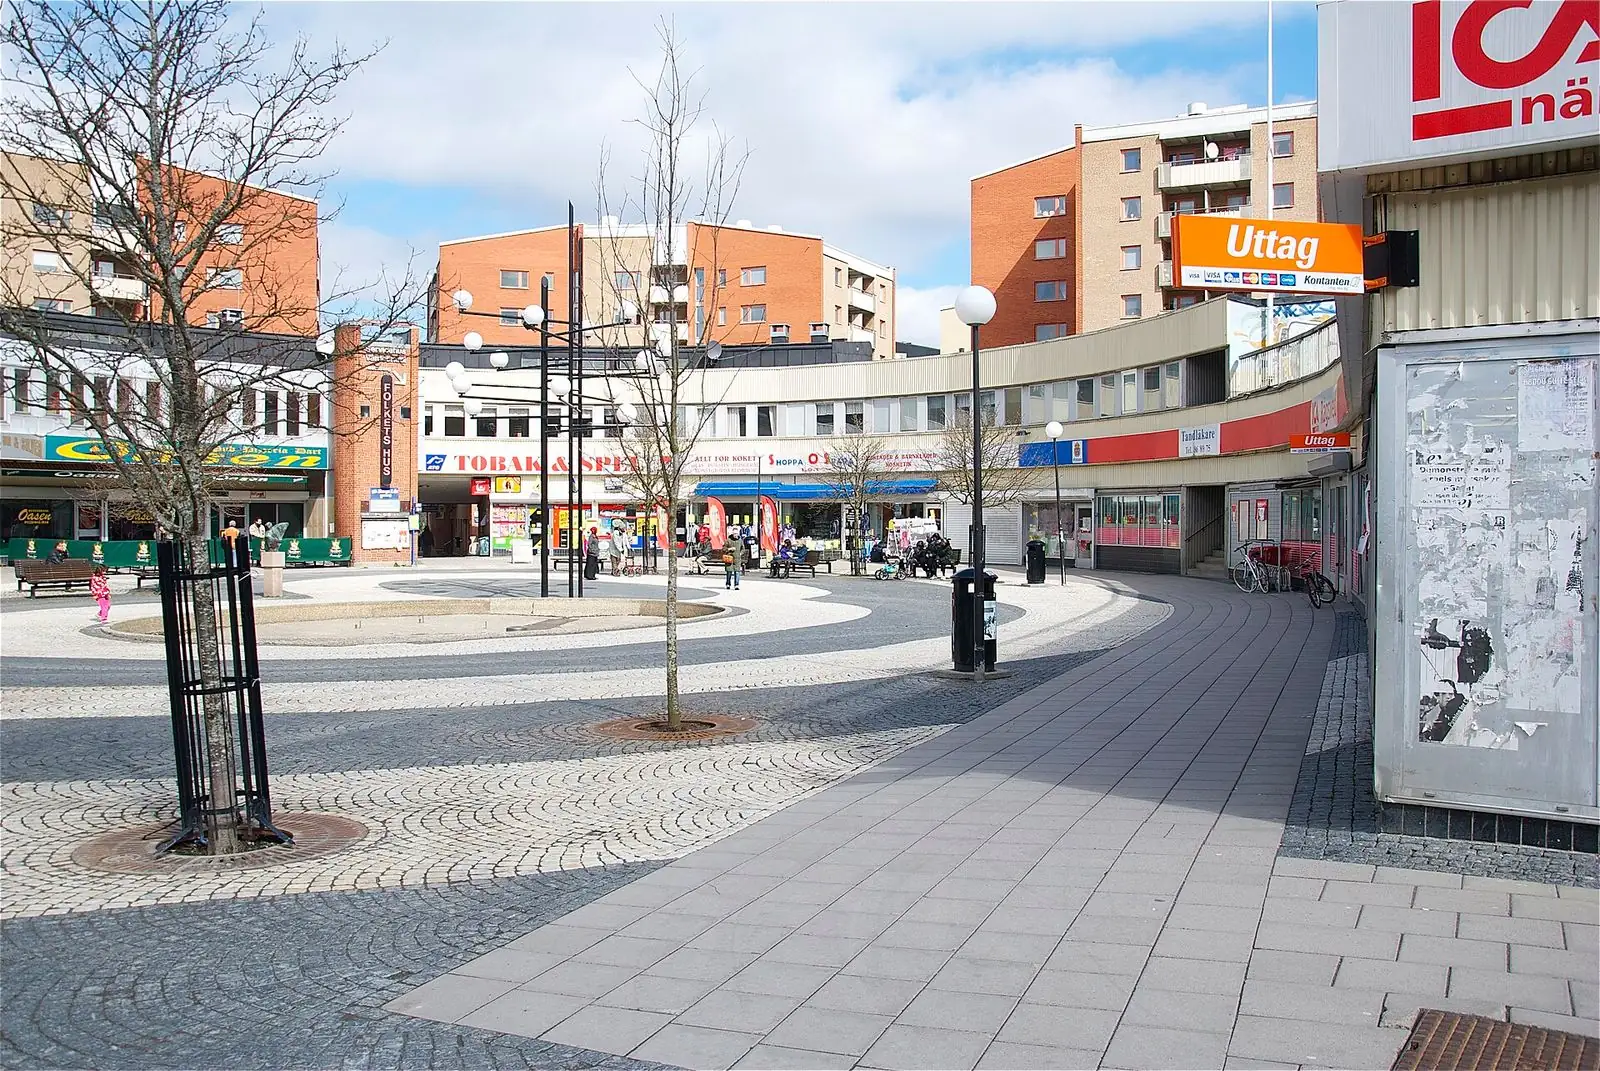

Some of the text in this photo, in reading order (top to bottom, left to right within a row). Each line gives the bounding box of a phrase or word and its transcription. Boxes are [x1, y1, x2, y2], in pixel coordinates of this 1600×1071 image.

[1521, 77, 1600, 126] nä
[1226, 224, 1320, 270] Uttag
[1206, 271, 1221, 279] VISA
[1303, 274, 1350, 286] Kontanten
[382, 383, 392, 445] FOLKETS
[1304, 435, 1336, 446] Uttag
[382, 449, 392, 476] HUS
[453, 455, 541, 471] TOBAK
[552, 456, 569, 471] &
[768, 453, 803, 466] SHOPPA
[17, 508, 52, 522] Oasen
